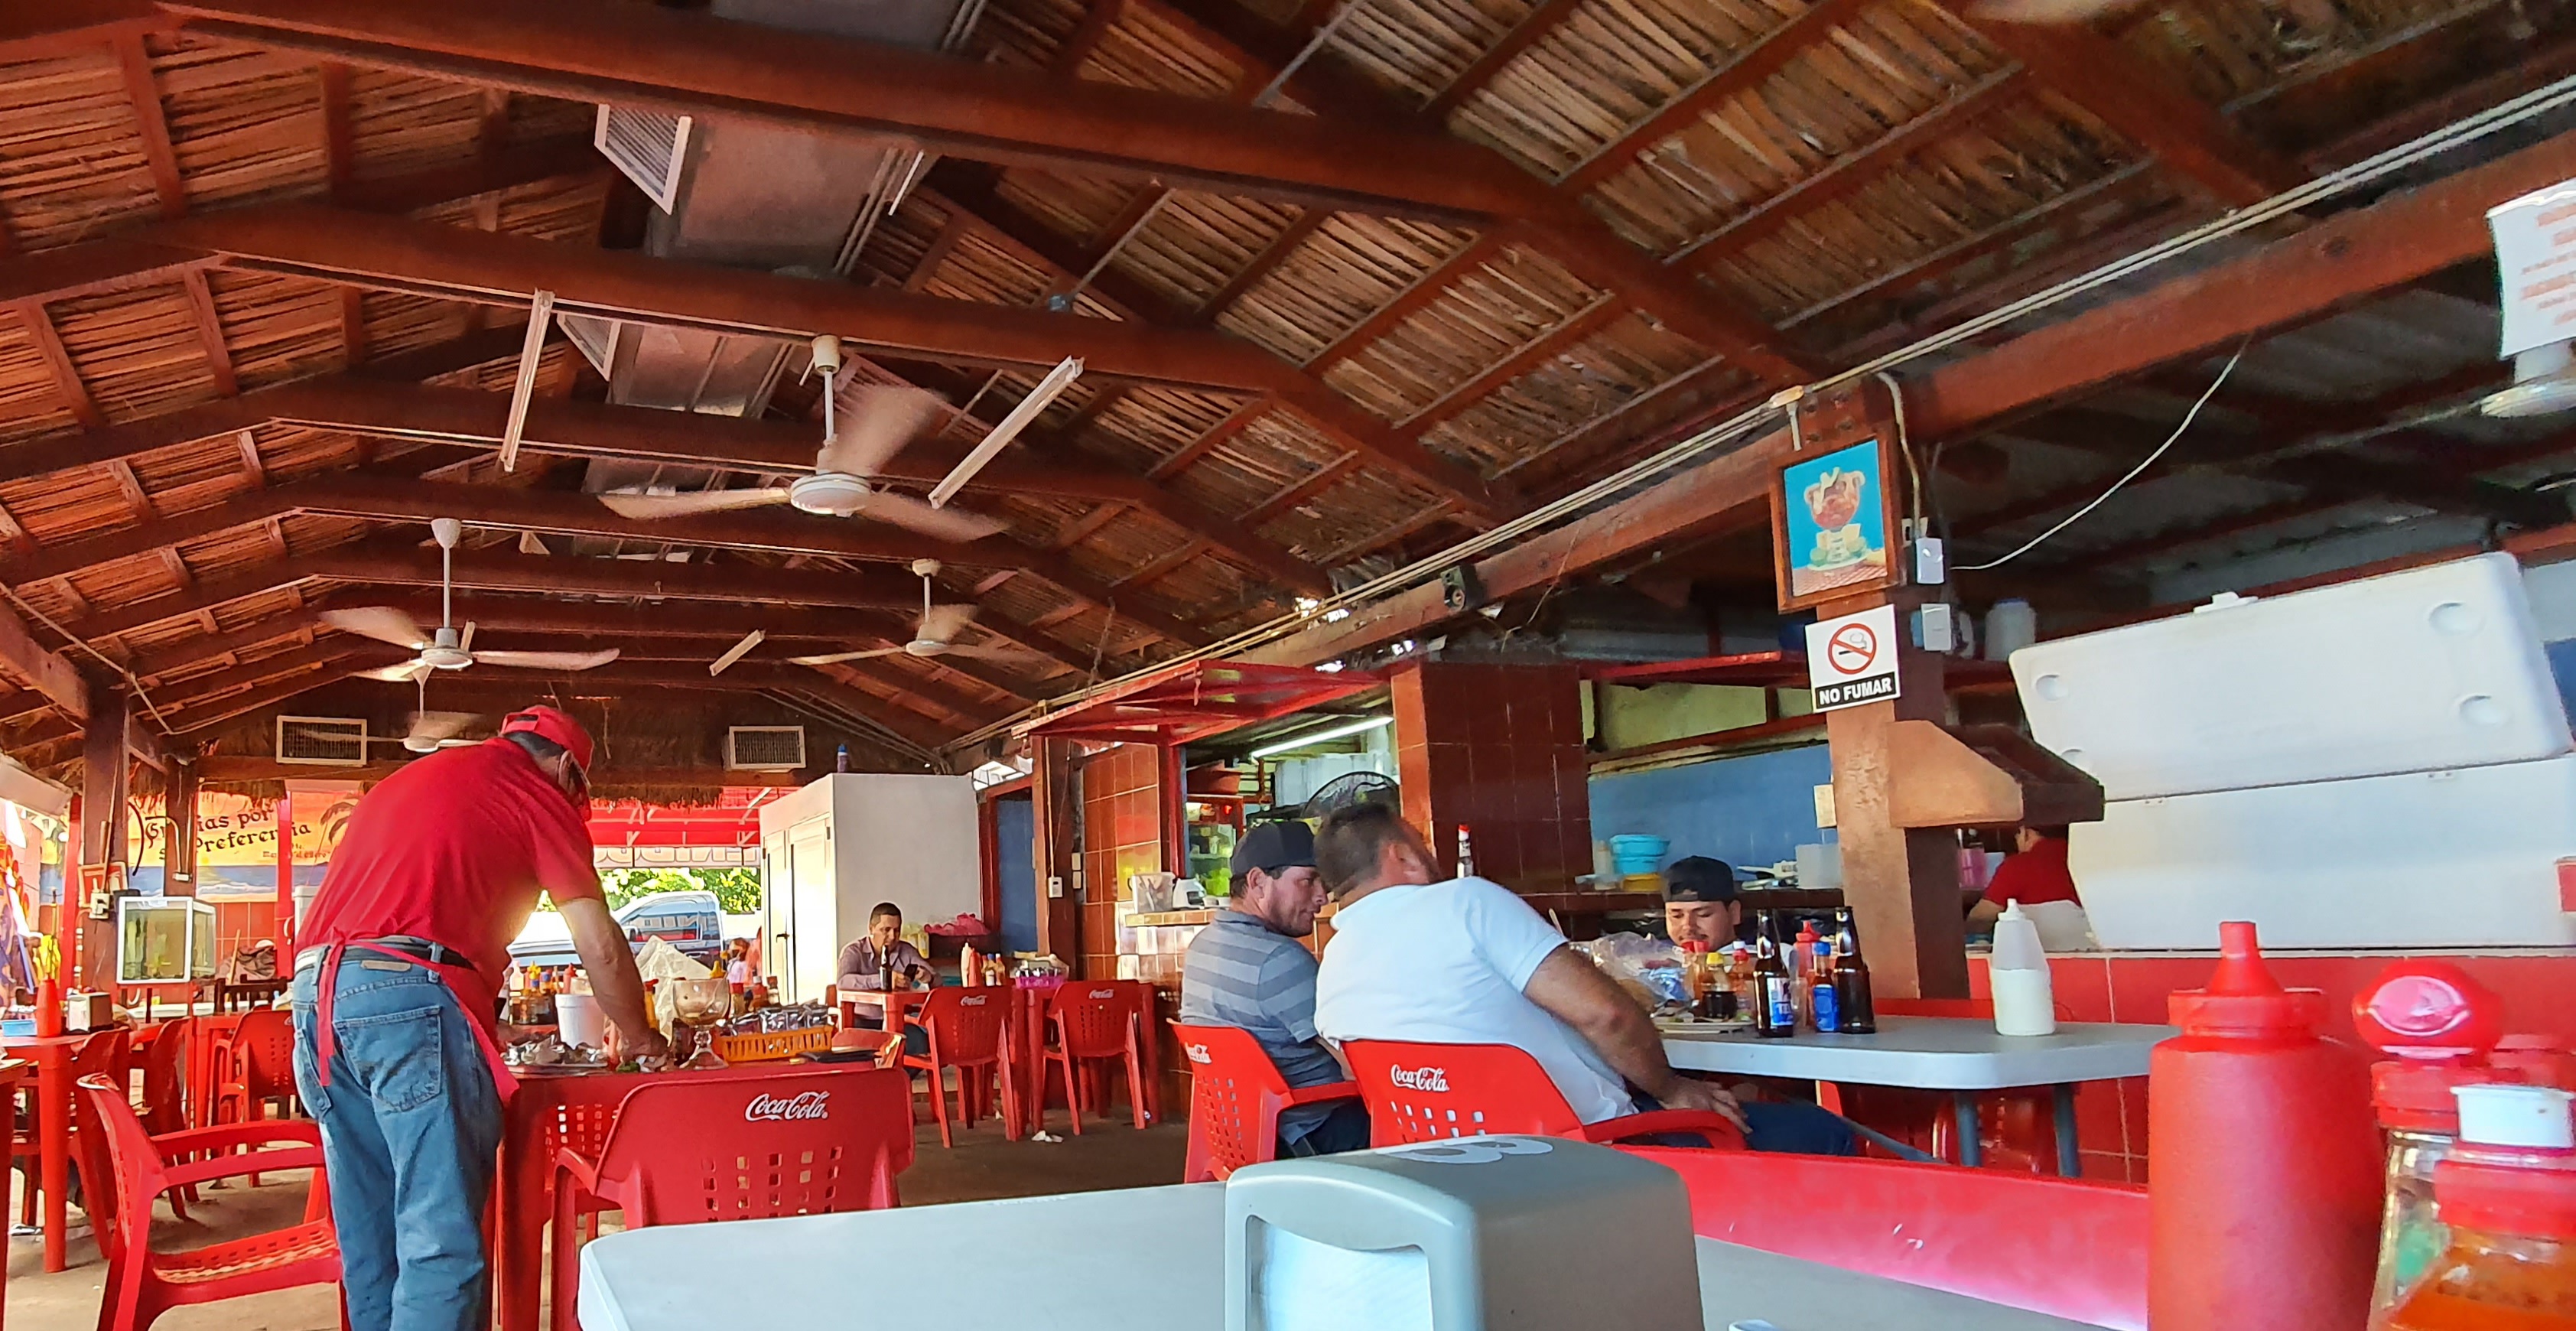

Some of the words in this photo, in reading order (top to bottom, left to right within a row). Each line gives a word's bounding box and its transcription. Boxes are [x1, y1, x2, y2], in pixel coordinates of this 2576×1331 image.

[1819, 688, 1841, 705] NO
[1843, 677, 1893, 701] FUMAR
[237, 809, 274, 829] por
[745, 1090, 830, 1121] Coca-Cola
